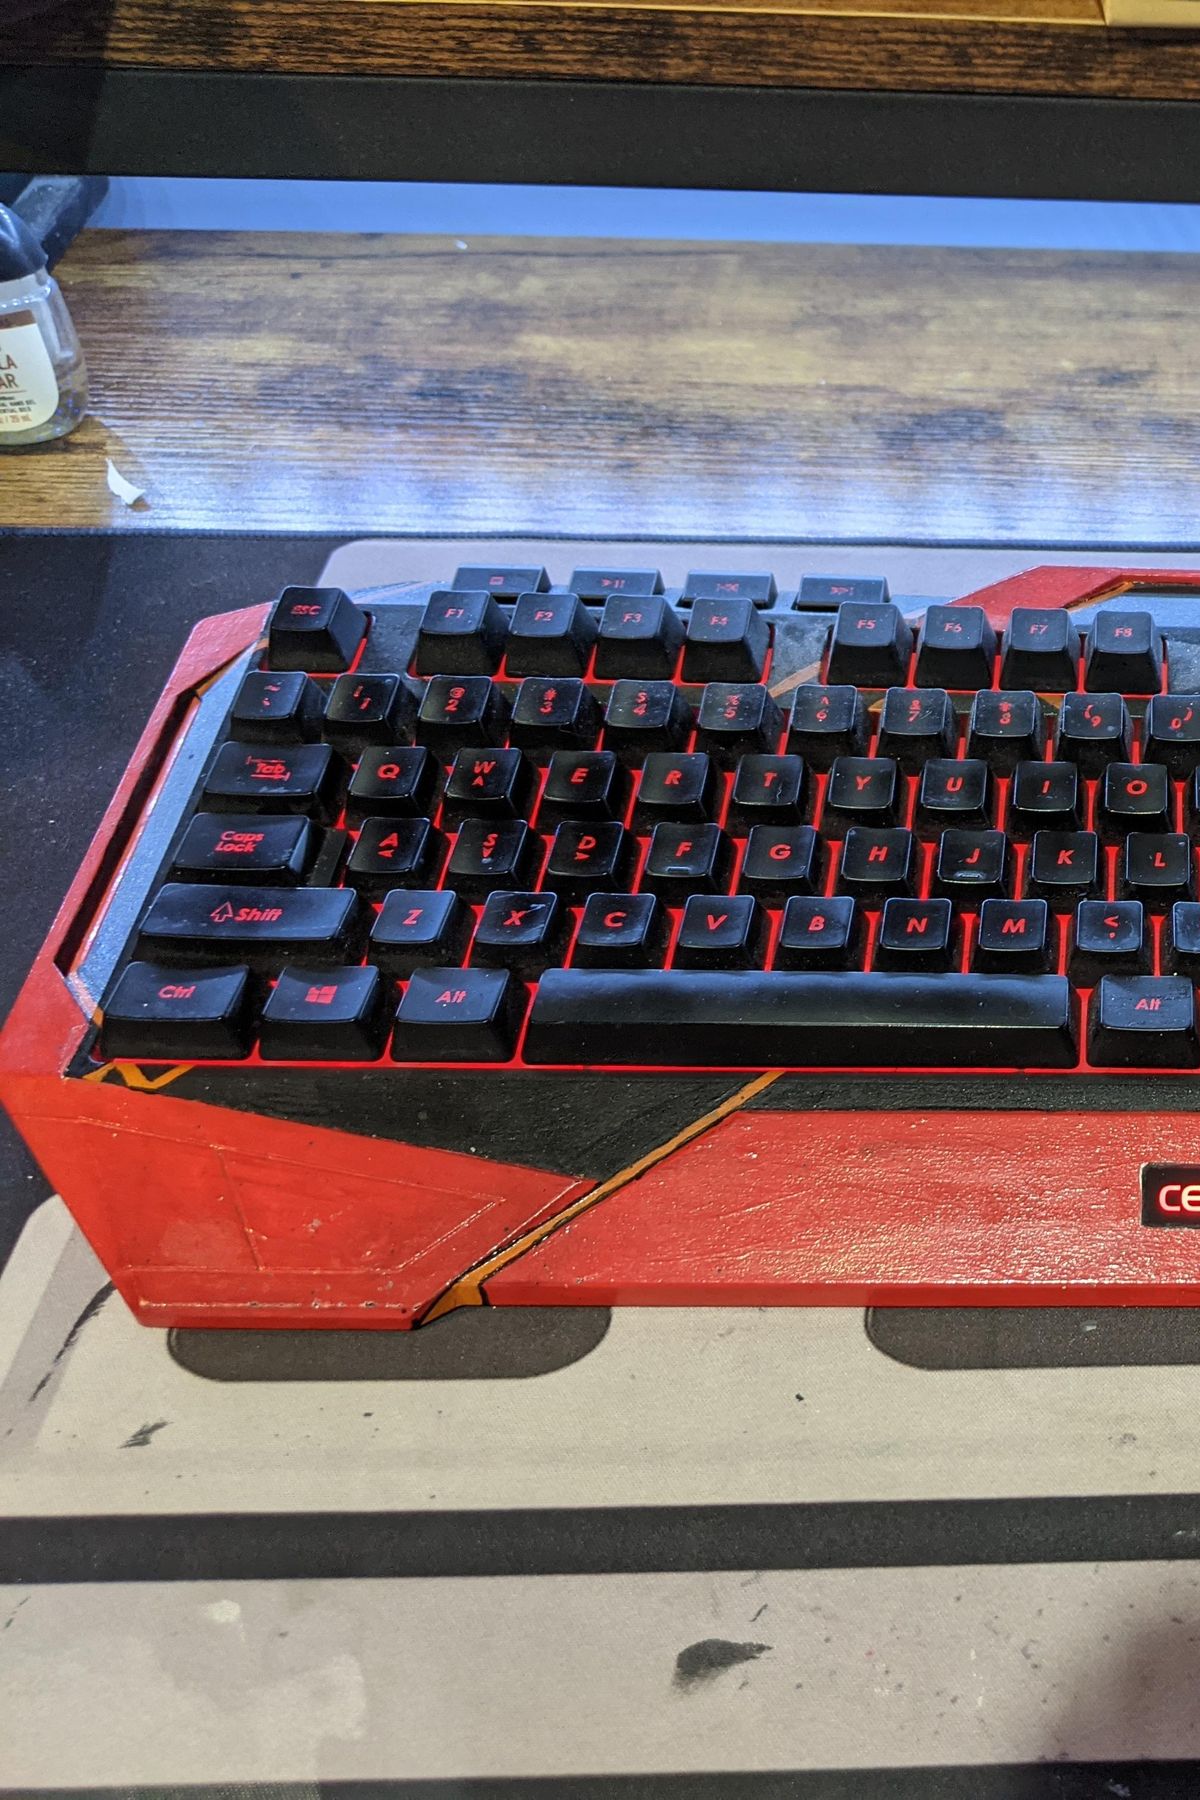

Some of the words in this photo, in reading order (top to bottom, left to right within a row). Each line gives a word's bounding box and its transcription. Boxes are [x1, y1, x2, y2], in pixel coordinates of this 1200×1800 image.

[290, 604, 322, 616] ESC
[444, 608, 464, 618] F1
[534, 611, 555, 622] F2
[623, 612, 643, 624] F3
[710, 616, 729, 626] F4
[857, 619, 876, 629] F5
[943, 622, 963, 633] F6
[1029, 624, 1048, 635] F7
[1114, 627, 1133, 638] F8
[444, 699, 459, 711] 2
[540, 702, 554, 714] 3
[633, 703, 647, 716] 4
[724, 707, 738, 719] 5
[816, 709, 828, 721] 6
[908, 711, 921, 723] 7
[1000, 712, 1012, 725] 8
[1090, 715, 1102, 728] 9
[254, 762, 286, 773] Tab
[377, 764, 401, 779] Q
[473, 761, 496, 774] W
[571, 768, 589, 783] E
[664, 770, 683, 785] R
[763, 772, 778, 788] T
[856, 775, 872, 791] Y
[946, 777, 964, 792] U
[1041, 780, 1051, 794] I
[1126, 779, 1148, 796] O
[219, 831, 265, 842] Caps
[379, 832, 399, 848] A
[483, 833, 498, 847] S
[578, 835, 597, 849] D
[214, 841, 259, 854] Lock
[676, 841, 692, 857] F
[769, 844, 792, 860] G
[868, 846, 889, 862] H
[965, 848, 981, 864] J
[1056, 850, 1074, 866] K
[1154, 852, 1167, 868] L
[234, 907, 284, 922] Shift
[403, 909, 424, 925] Z
[503, 910, 527, 926] X
[604, 911, 627, 928] C
[706, 914, 728, 930] V
[808, 915, 825, 931] B
[907, 917, 929, 934] N
[1002, 918, 1026, 934] M
[157, 985, 196, 999] Ctrl
[435, 990, 466, 1003] Alt
[1134, 998, 1161, 1011] Alt
